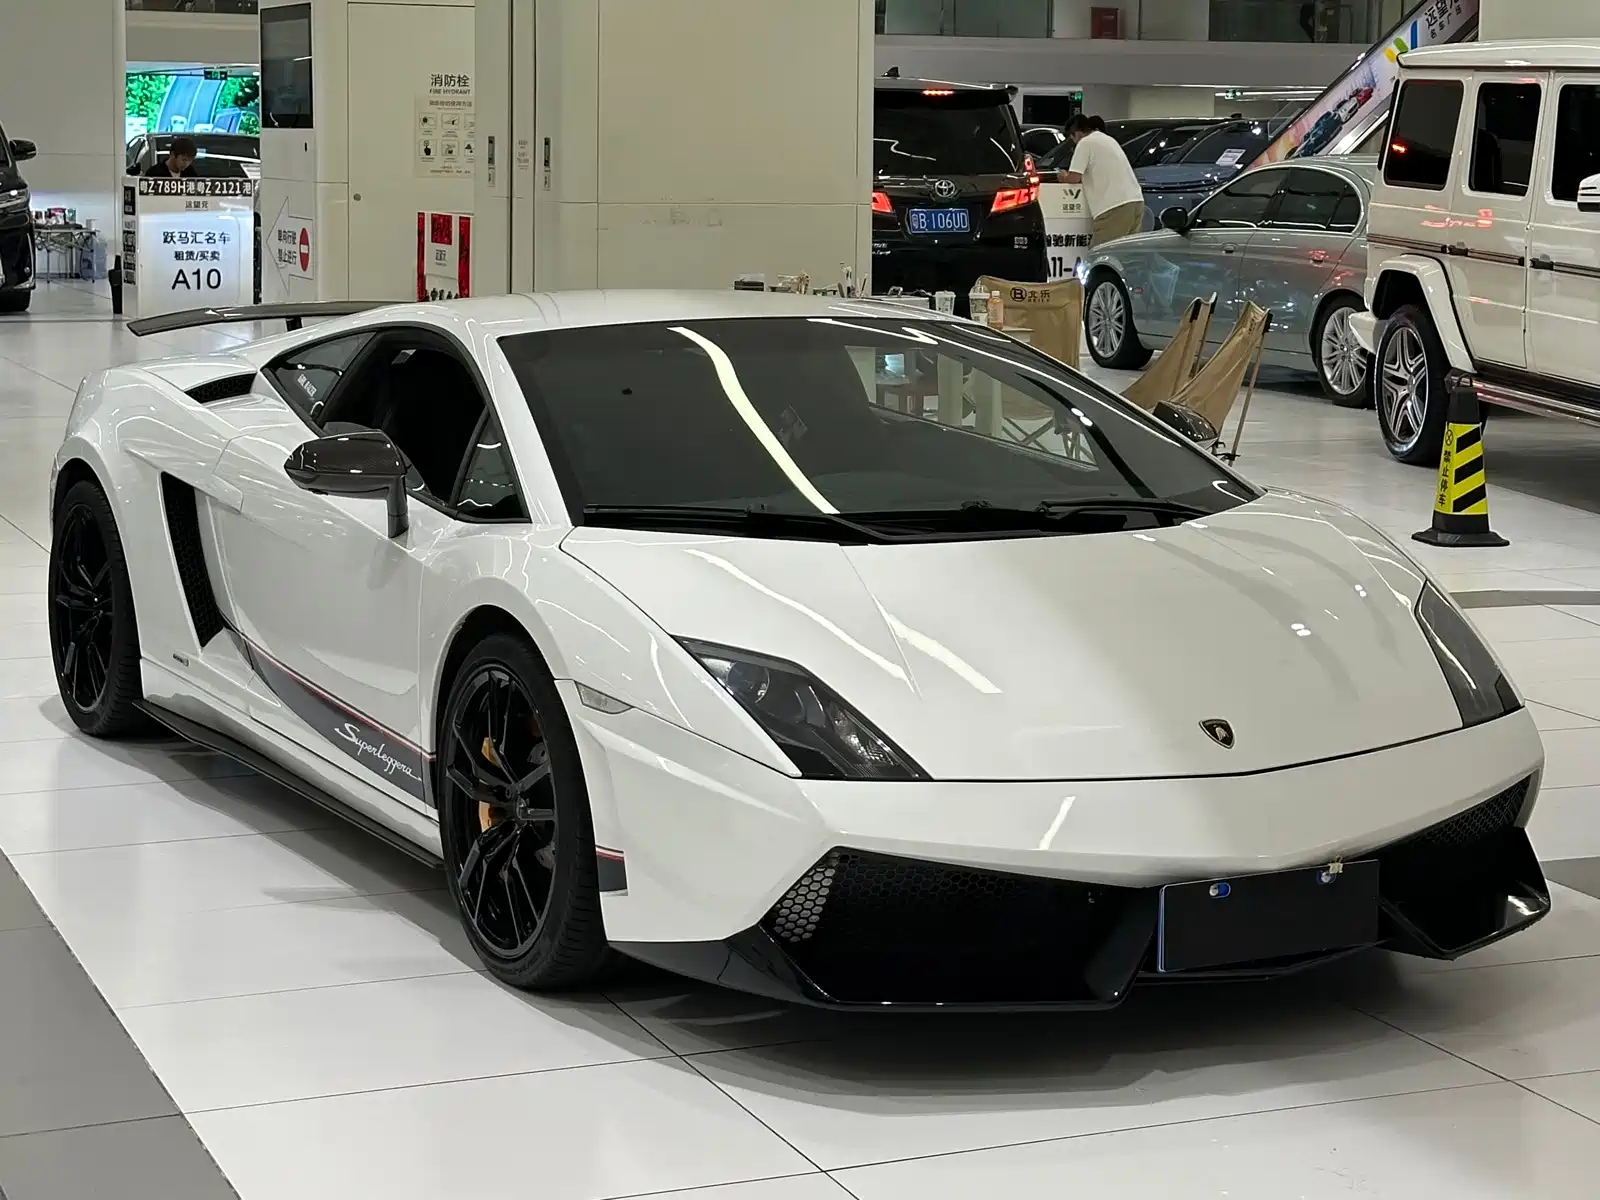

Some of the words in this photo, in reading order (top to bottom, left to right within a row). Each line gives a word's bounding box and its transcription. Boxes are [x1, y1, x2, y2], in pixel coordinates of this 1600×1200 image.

[430, 74, 470, 88] 消防栓
[163, 231, 231, 245] 跃马汇名车
[174, 250, 221, 261] 租赁/买卖
[171, 268, 222, 290] A10
[1438, 449, 1452, 507] 禁止停车
[333, 722, 422, 782] Superleggera
